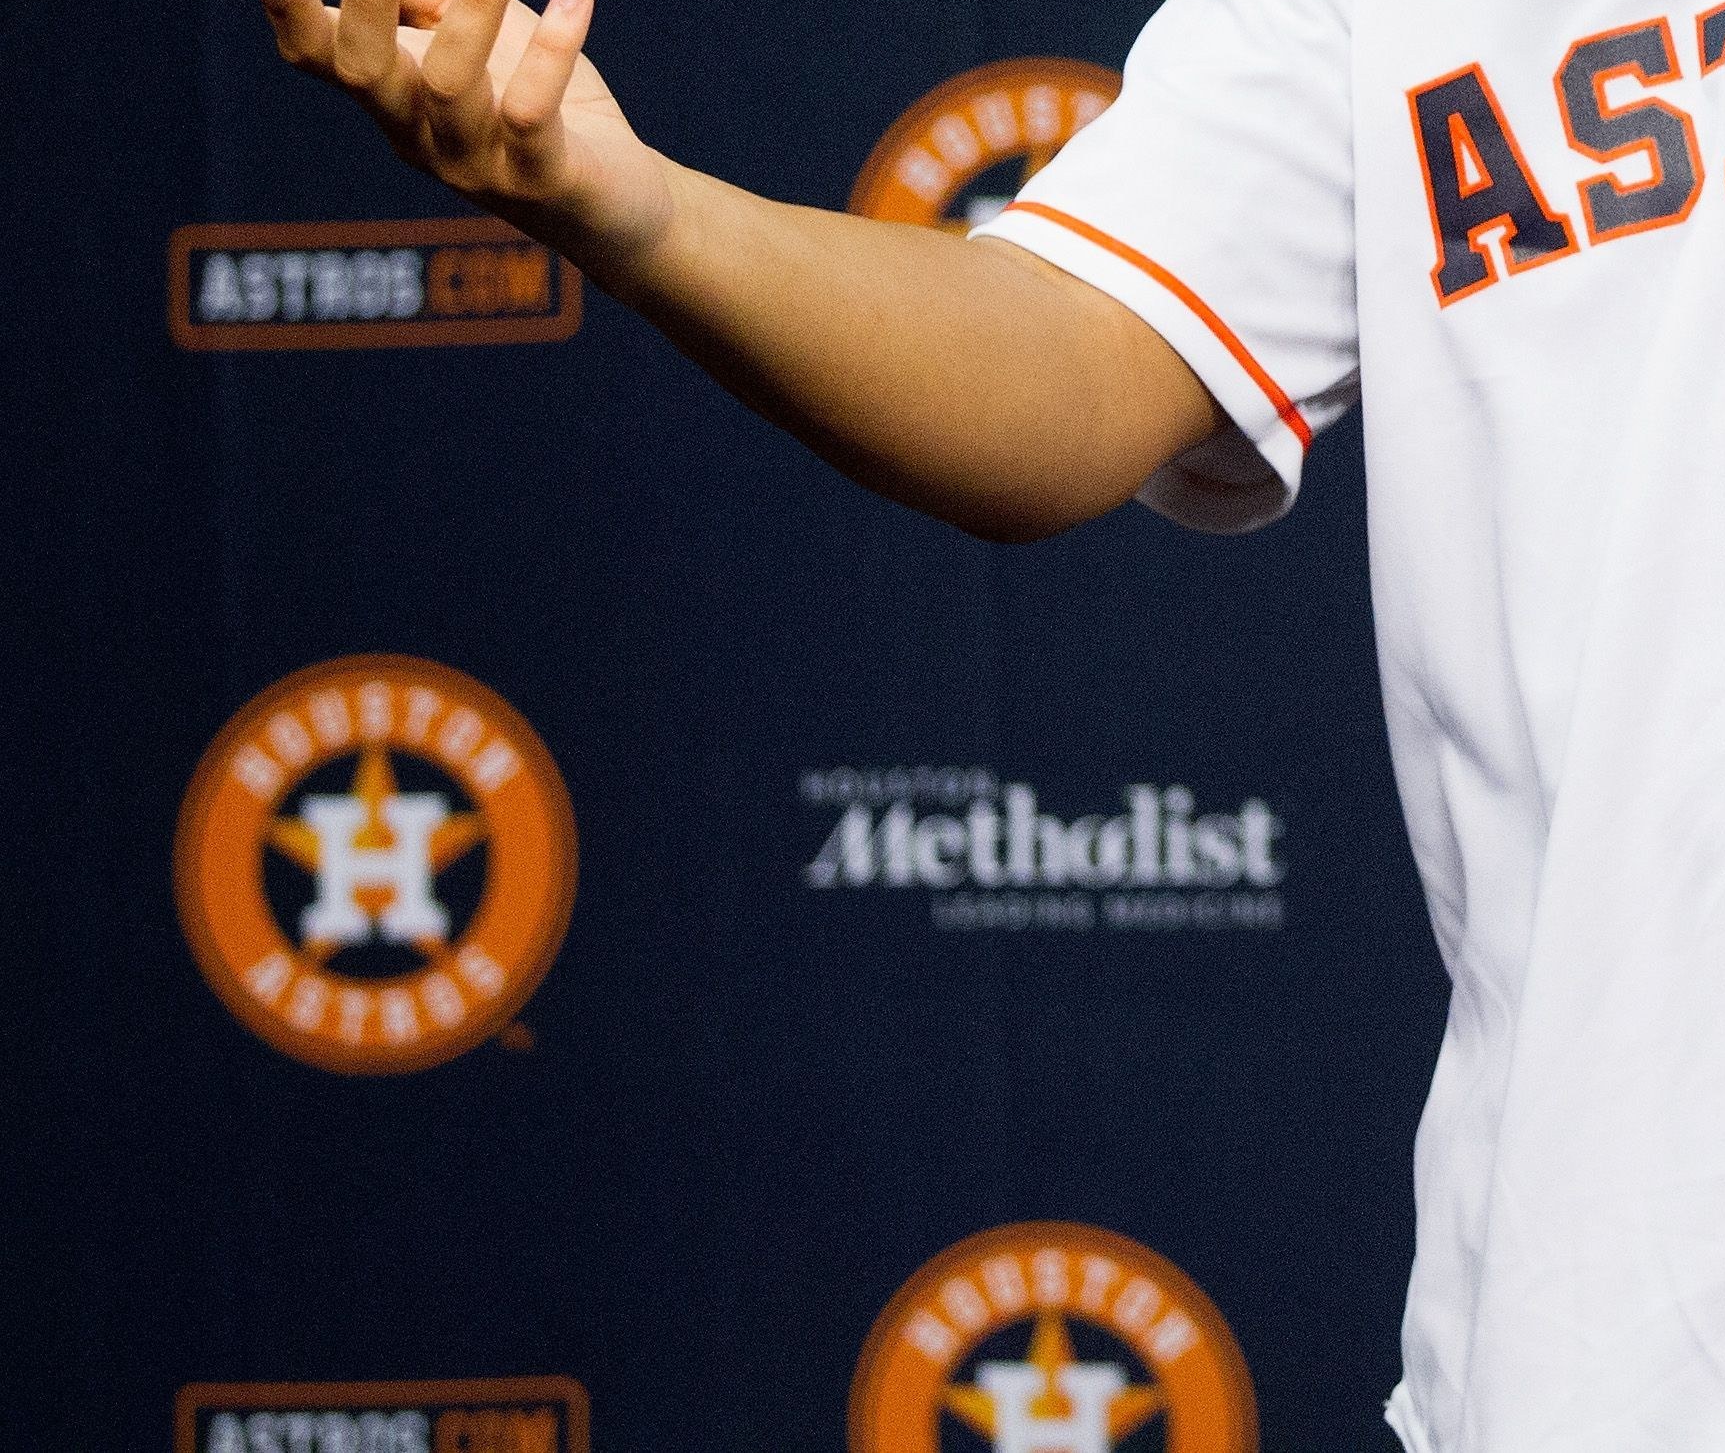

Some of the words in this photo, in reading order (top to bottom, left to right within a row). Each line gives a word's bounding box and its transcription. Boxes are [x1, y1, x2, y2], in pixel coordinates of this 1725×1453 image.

[896, 85, 1112, 201] HOUST
[231, 680, 521, 799] HOUSTON
[300, 791, 451, 945] H
[804, 780, 1287, 888] Methodist
[244, 944, 507, 1047] ASTROS
[900, 1244, 1205, 1362] HOUSTON
